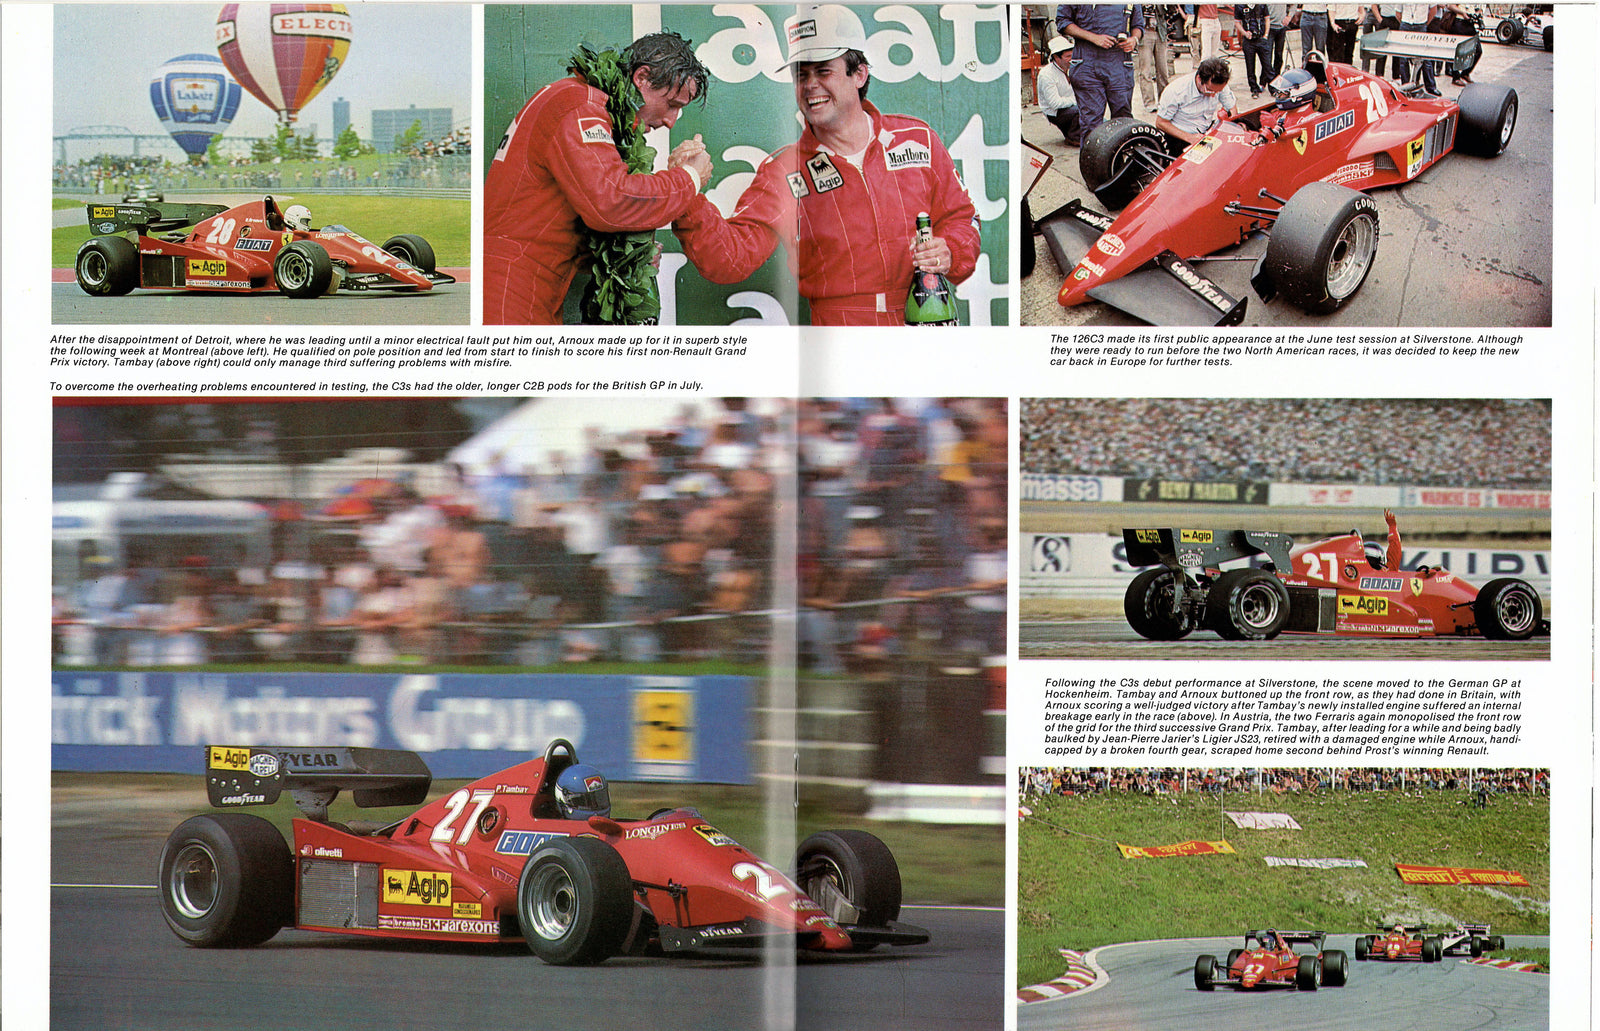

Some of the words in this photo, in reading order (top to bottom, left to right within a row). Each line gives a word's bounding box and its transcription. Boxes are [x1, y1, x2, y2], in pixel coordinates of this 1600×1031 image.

[1358, 80, 1389, 124] 28
[1316, 112, 1354, 141] FIAT
[586, 129, 613, 140] Marlbo
[888, 148, 930, 164] Marlboro
[818, 175, 842, 191] Agip
[205, 216, 237, 245] 28
[236, 239, 271, 250] FIAT
[202, 260, 225, 275] Agip
[1171, 261, 1232, 312] GOODYEAR
[1051, 334, 1069, 343] The
[1073, 334, 1104, 344] 126C3
[1107, 334, 1136, 344] made
[1138, 334, 1151, 343] its
[1154, 334, 1174, 343] first
[1176, 334, 1209, 345] public
[1212, 336, 1273, 345] appearance
[1275, 335, 1285, 344] at
[1288, 335, 1305, 343] the
[1307, 335, 1333, 344] June
[1336, 335, 1356, 344] test
[1358, 335, 1397, 344] session
[1400, 335, 1410, 344] at
[1413, 334, 1474, 344] Silverstone.
[1477, 335, 1523, 346] Although
[50, 357, 70, 366] Prix
[73, 357, 110, 369] victory.
[114, 358, 154, 369] Tambay
[156, 358, 191, 368] (above
[193, 358, 221, 369] right)
[223, 358, 252, 367] could
[254, 358, 277, 369] only
[279, 360, 321, 369] manage
[324, 358, 348, 367] third
[349, 358, 396, 369] suffering
[398, 358, 447, 369] problems
[450, 358, 471, 367] with
[474, 358, 512, 367] misfire.
[51, 382, 63, 391] To
[118, 382, 134, 391] the
[136, 382, 198, 393] overheating
[200, 382, 248, 393] problems
[250, 382, 317, 391] encountered
[318, 382, 328, 391] in
[331, 382, 368, 393] testing,
[372, 382, 389, 391] the
[391, 381, 412, 391] C3s
[414, 382, 434, 391] had
[437, 382, 453, 391] the
[455, 382, 483, 392] older,
[487, 382, 521, 393] longer
[523, 381, 545, 390] C2B
[547, 381, 572, 392] pods
[575, 381, 590, 390] for
[592, 381, 609, 390] the
[612, 381, 647, 390] British
[649, 381, 666, 390] GP
[668, 381, 678, 389] in
[680, 381, 703, 392] July.
[1192, 531, 1211, 542] Agip
[1302, 552, 1339, 583] 27
[1361, 578, 1401, 591] FIAT
[1357, 596, 1387, 614] Agip
[1045, 678, 1096, 690] Following
[1100, 678, 1117, 687] the
[1120, 678, 1140, 688] C3s
[1143, 678, 1172, 688] debut
[1175, 678, 1242, 689] performance
[1245, 679, 1255, 688] at
[1258, 678, 1318, 688] Silverstone,
[1323, 679, 1340, 688] the
[1376, 679, 1410, 688] moved
[1414, 680, 1424, 688] to
[1428, 679, 1445, 688] the
[1448, 679, 1489, 688] German
[1492, 679, 1508, 688] GP
[1511, 680, 1521, 688] at
[1044, 745, 1083, 756] capped
[1085, 745, 1098, 757] by
[1100, 747, 1107, 755] a
[1110, 746, 1146, 755] broken
[1148, 745, 1179, 755] fourth
[1181, 747, 1207, 757] gear,
[1211, 746, 1253, 756] scraped
[1255, 746, 1283, 755] home
[1286, 746, 1324, 755] second
[1326, 746, 1363, 755] behind
[1365, 746, 1400, 755] Prost's
[1403, 746, 1444, 757] winning
[1447, 746, 1489, 755] Renault.
[224, 750, 248, 768] Agip
[222, 793, 265, 805] GOODYEAR
[430, 788, 495, 846] 27
[625, 822, 687, 840] LONGINES
[314, 846, 343, 858] olivetti
[406, 871, 449, 904] Agip
[421, 918, 449, 931] SKF
[448, 921, 500, 934] arexons
[1242, 964, 1265, 975] 27
